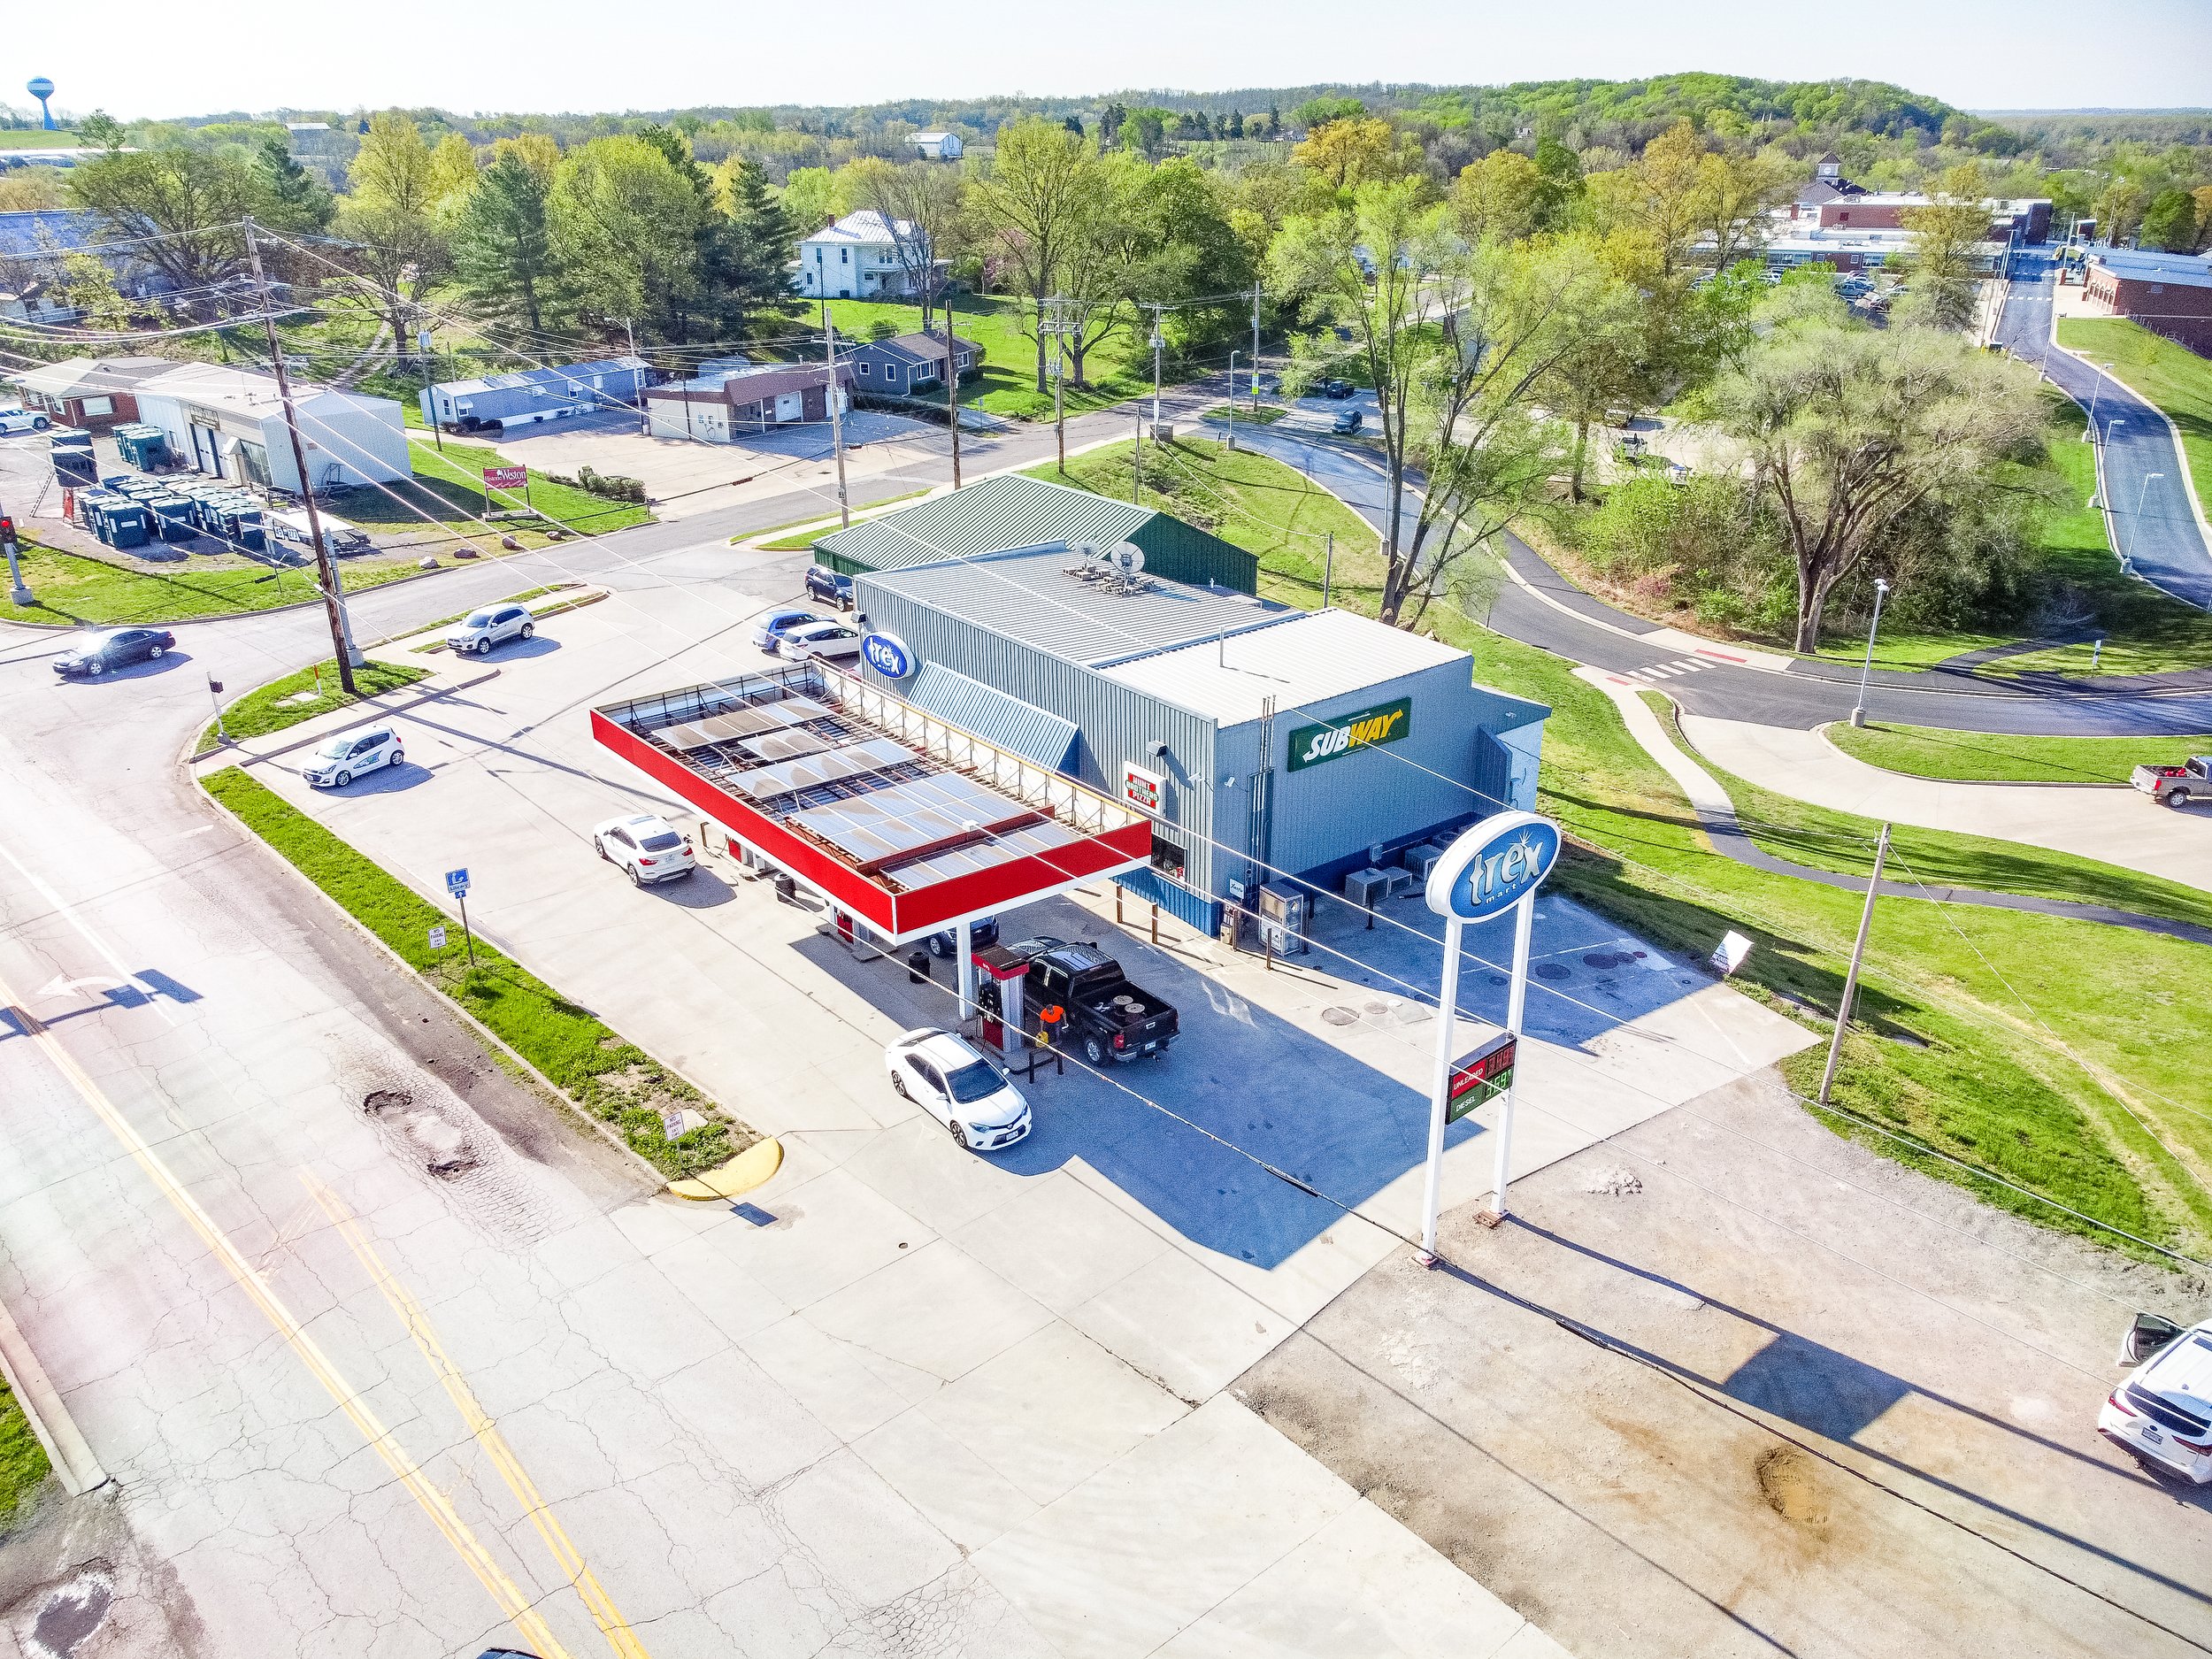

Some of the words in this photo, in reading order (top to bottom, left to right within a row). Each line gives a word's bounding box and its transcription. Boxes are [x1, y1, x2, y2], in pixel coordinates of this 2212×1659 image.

[501, 469, 526, 480] Weston
[1302, 709, 1403, 763] SUBWAY
[1125, 780, 1158, 802] BROTHERS
[1133, 775, 1151, 789] HUNT
[1133, 790, 1151, 806] PIZZA
[1469, 841, 1543, 906] trex
[1486, 883, 1517, 904] mart
[1454, 1067, 1484, 1090] UNLEADED
[1455, 1095, 1477, 1112] DIESEL
[666, 1119, 681, 1130] PARKING
